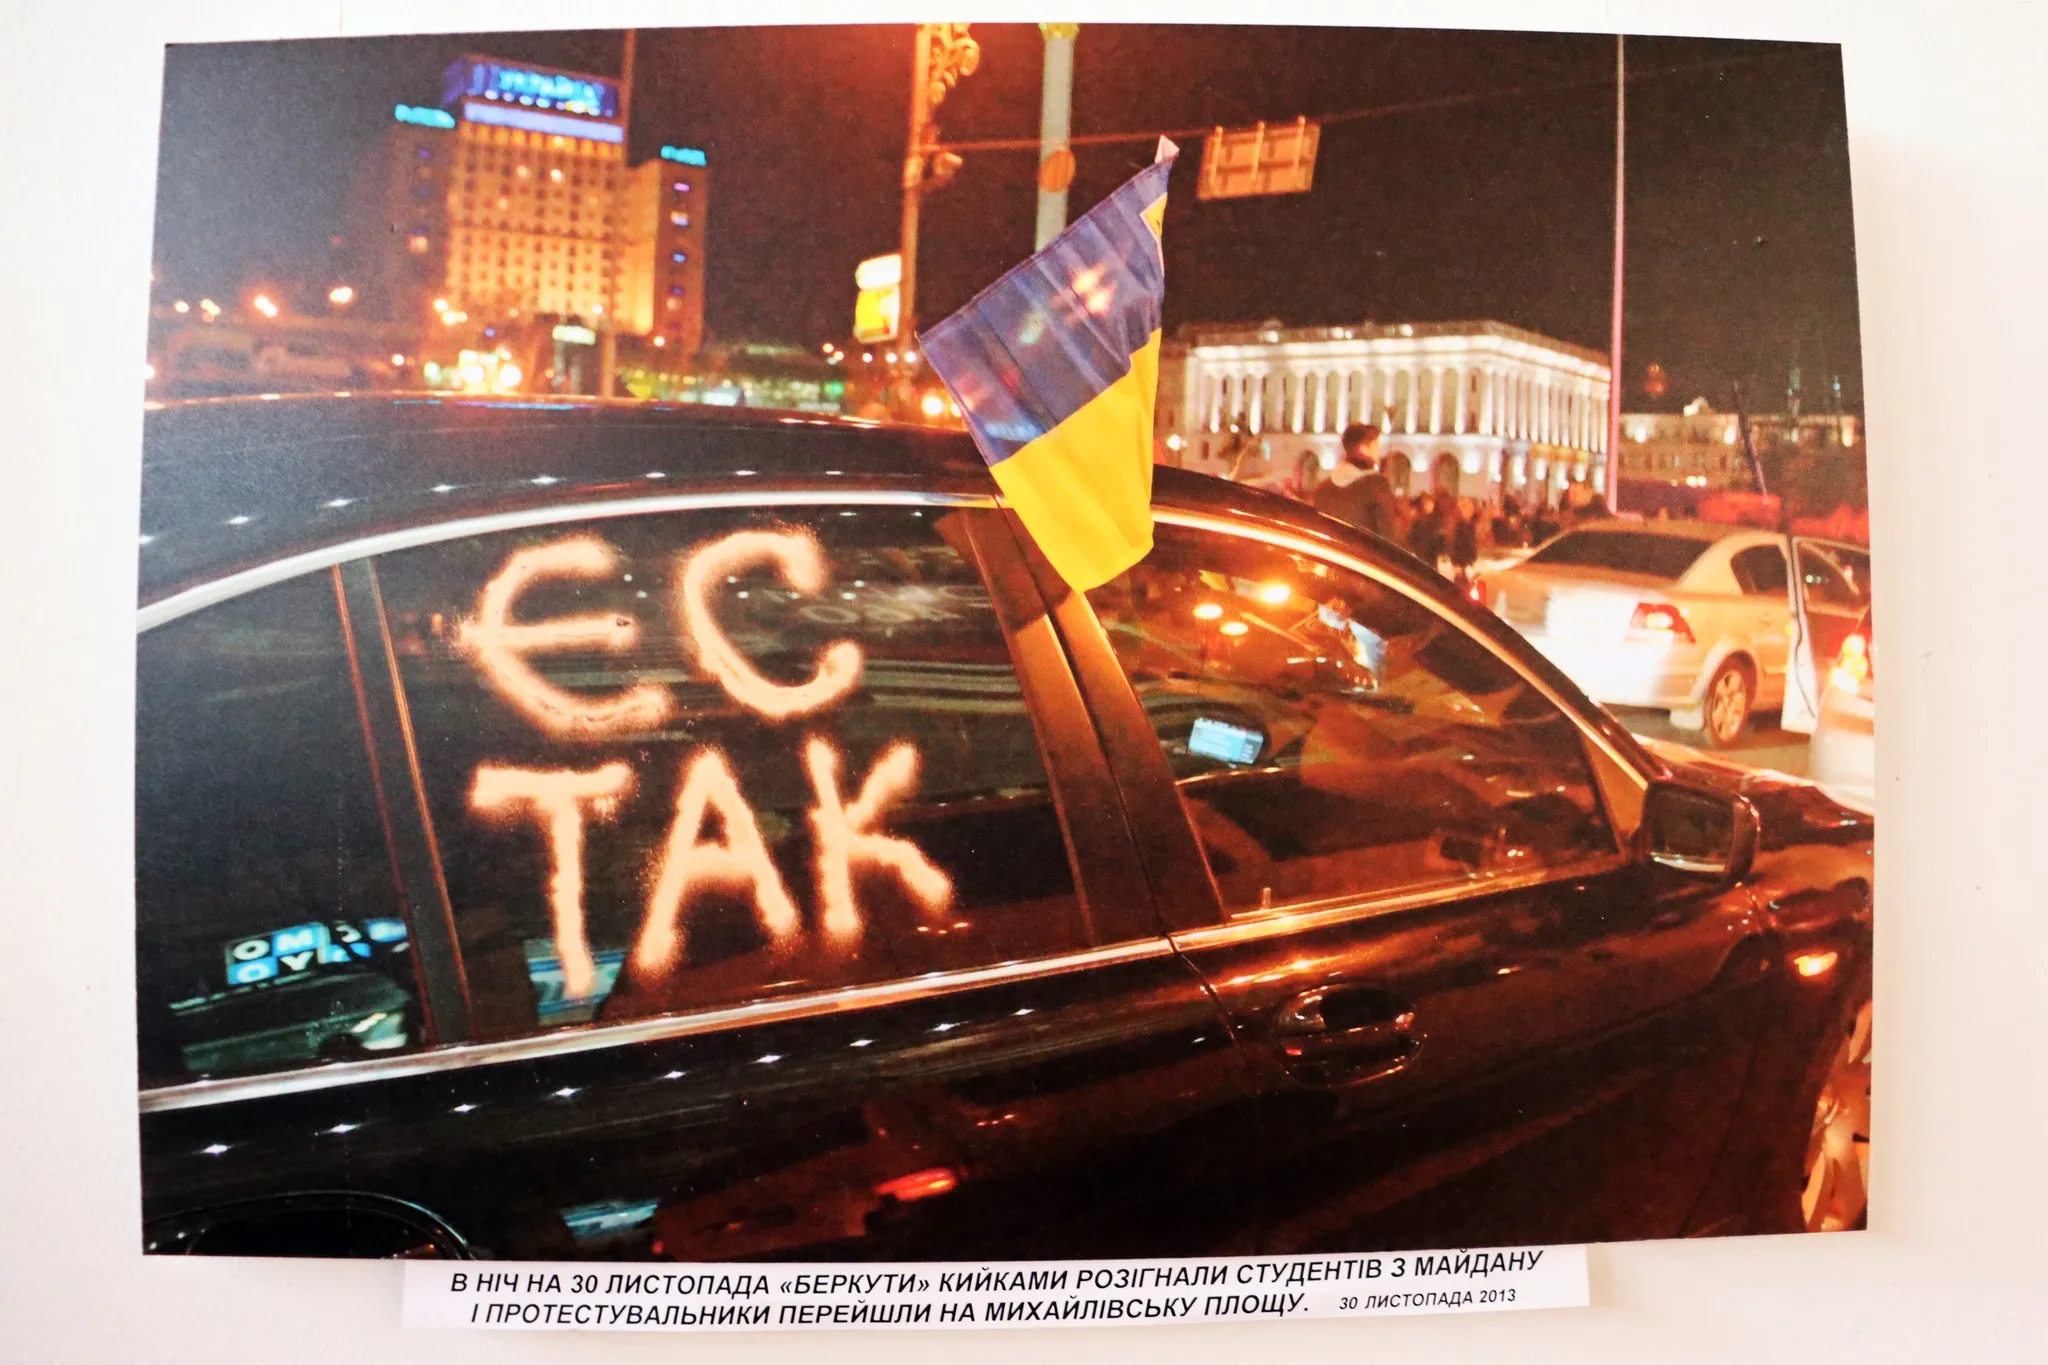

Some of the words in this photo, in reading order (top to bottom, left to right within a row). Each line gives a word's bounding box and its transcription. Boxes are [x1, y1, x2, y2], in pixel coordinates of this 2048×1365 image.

[467, 736, 952, 998] ТАК
[452, 1273, 467, 1292] В
[476, 1273, 518, 1293] НІЧ
[526, 1274, 560, 1293] НА
[570, 1274, 599, 1294] 30
[605, 1274, 769, 1299] ЛИСТОПАДА
[780, 1273, 930, 1295] «БЕРКУТИ»
[939, 1267, 1068, 1292] КИЙКАМИ
[1076, 1266, 1228, 1289] РОЗІГНАЛИ
[1236, 1258, 1382, 1288] СТУДЕНТІВ
[1414, 1248, 1544, 1278] МАЙДАНУ
[472, 1304, 479, 1323] І
[485, 1303, 771, 1325] ПРОТЕСТУВАЛЬНИКИ
[779, 1301, 932, 1324] ПЕРЕЙШЛИ
[939, 1302, 975, 1322] НА
[985, 1294, 1198, 1322] МИХАЙЛІВСЬКУ
[1204, 1292, 1308, 1317] ПЛОЩУ.
[1339, 1296, 1358, 1310] 30
[1364, 1291, 1473, 1309] ЛИСТОПАДА
[1479, 1288, 1516, 1303] 2013
